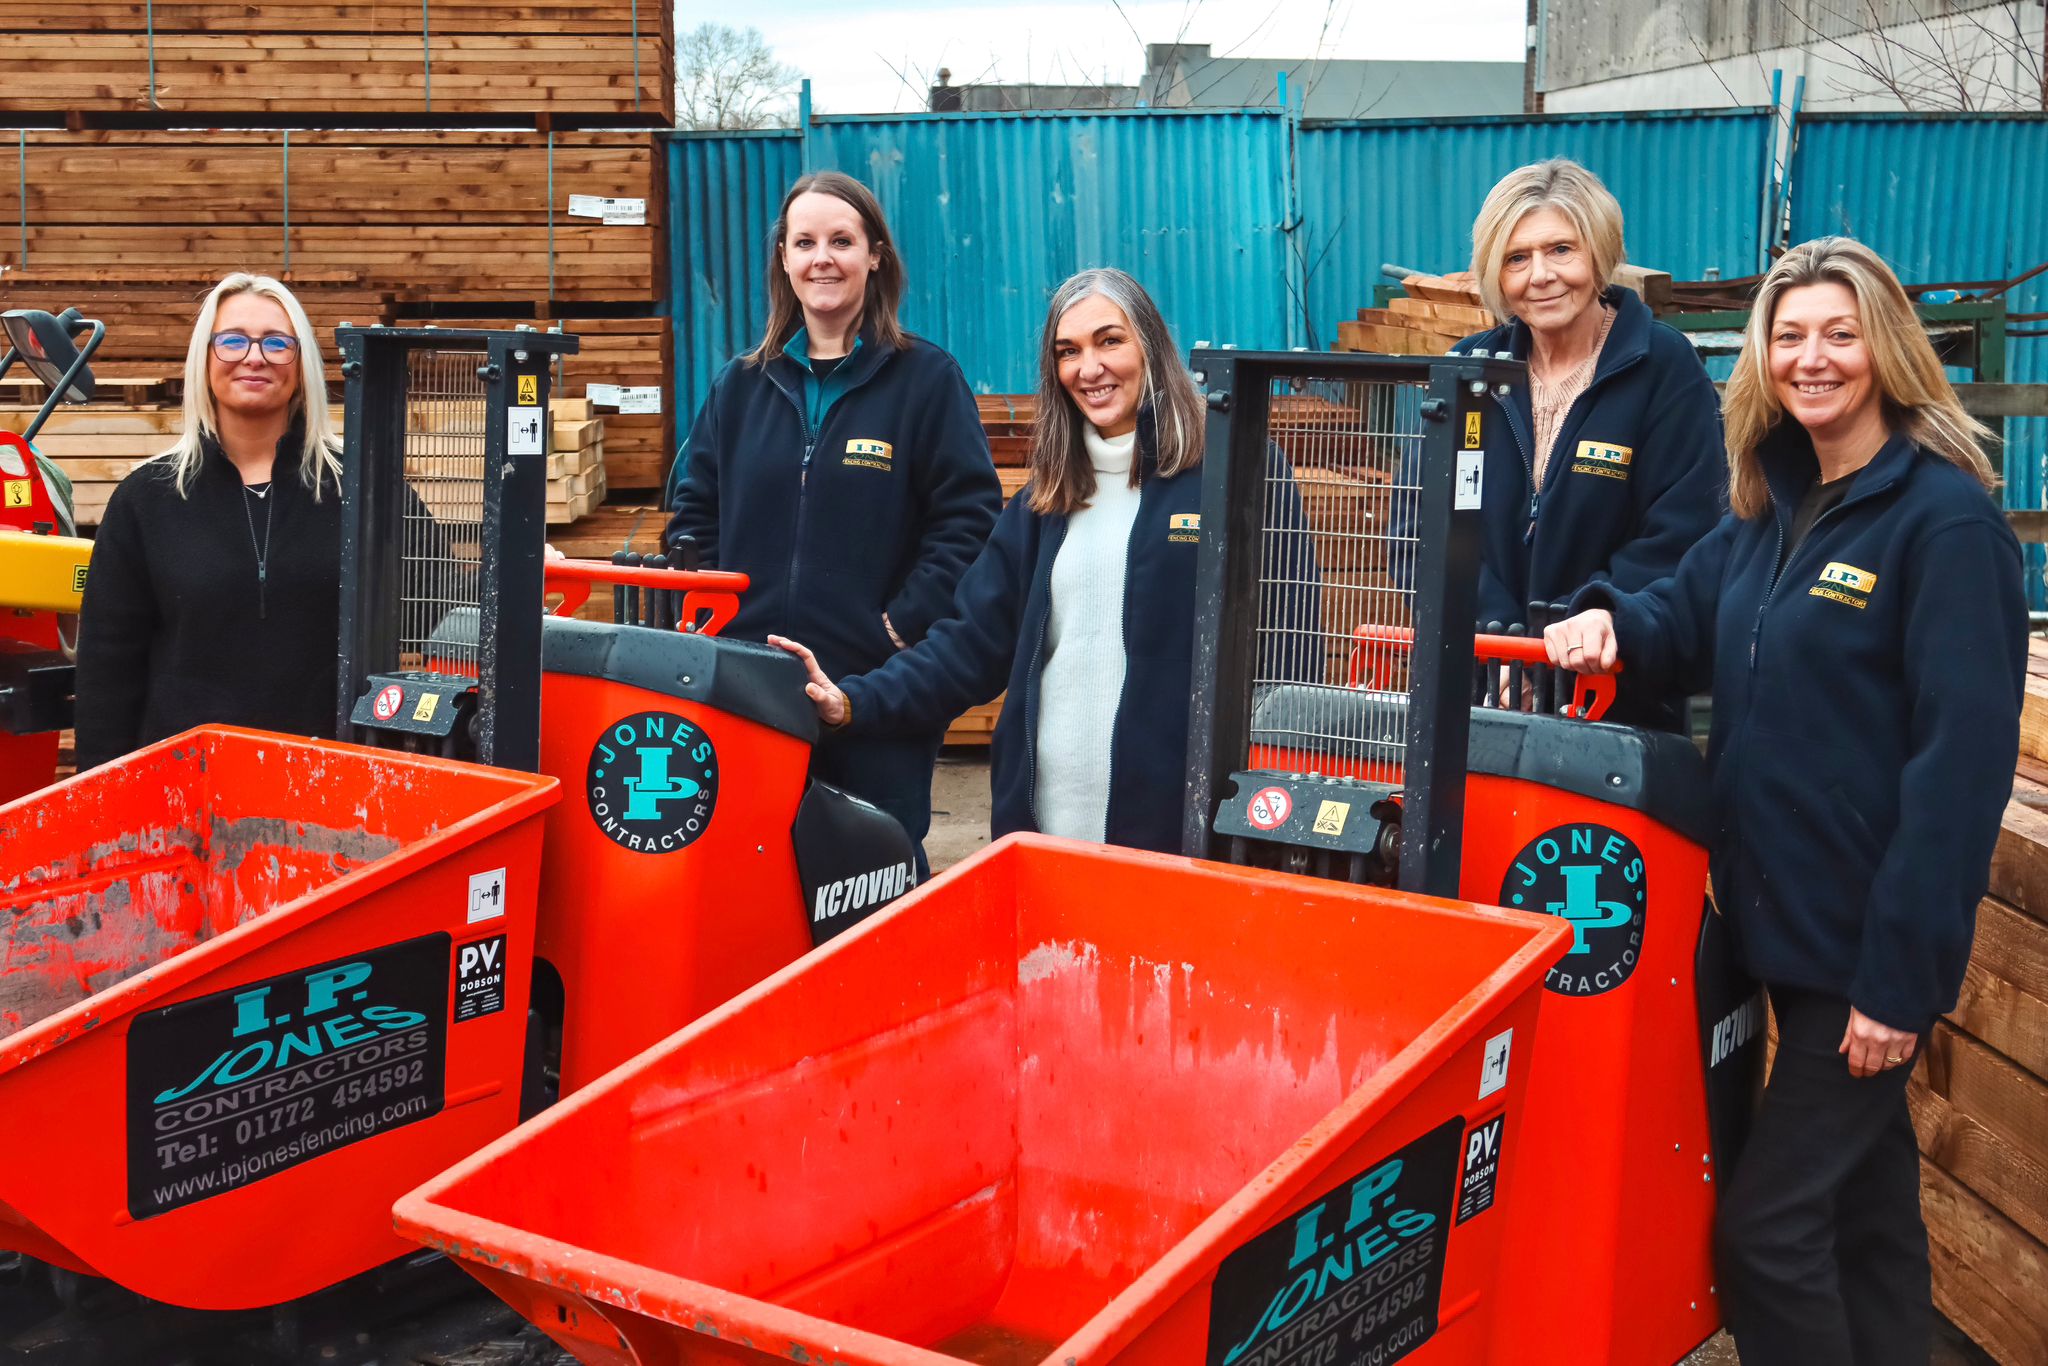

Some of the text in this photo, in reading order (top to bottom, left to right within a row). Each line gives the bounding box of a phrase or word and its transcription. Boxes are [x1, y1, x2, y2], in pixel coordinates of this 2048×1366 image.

[598, 717, 712, 765] JONES
[592, 786, 710, 851] CONTRACTORS
[1515, 829, 1643, 887] JONES
[459, 939, 501, 979] P.V.
[460, 974, 501, 993] DOBSON
[1545, 912, 1642, 993] TRACTORS
[153, 1005, 427, 1104] JONES
[154, 1030, 428, 1131] CONTRACTORS
[153, 1094, 428, 1205] www.ipjonesfencing.com
[156, 1060, 424, 1170] Tel: 01772 454592
[1466, 1120, 1500, 1171] P.V.
[1463, 1162, 1495, 1189] DOBSON
[1223, 1209, 1436, 1366] JONES
[1245, 1237, 1434, 1366] NTRACTORS
[1351, 1273, 1427, 1342] 454592
